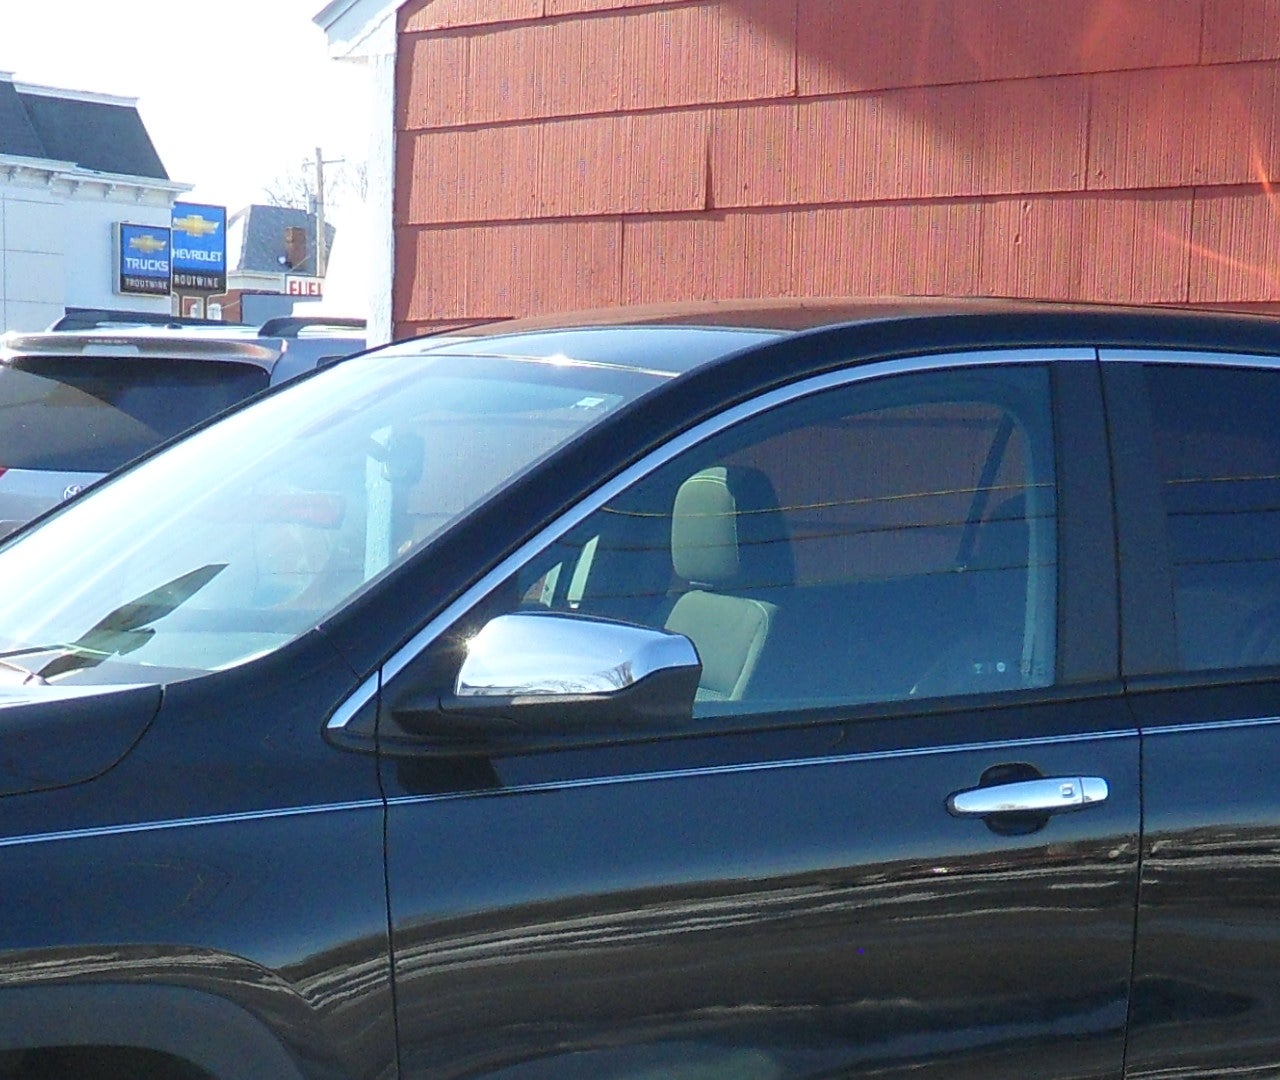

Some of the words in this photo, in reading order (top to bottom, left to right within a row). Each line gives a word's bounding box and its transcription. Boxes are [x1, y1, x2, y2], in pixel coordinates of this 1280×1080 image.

[172, 248, 222, 263] HEVROLET
[125, 257, 168, 272] TRUCKS
[172, 274, 219, 289] ROUTWINE
